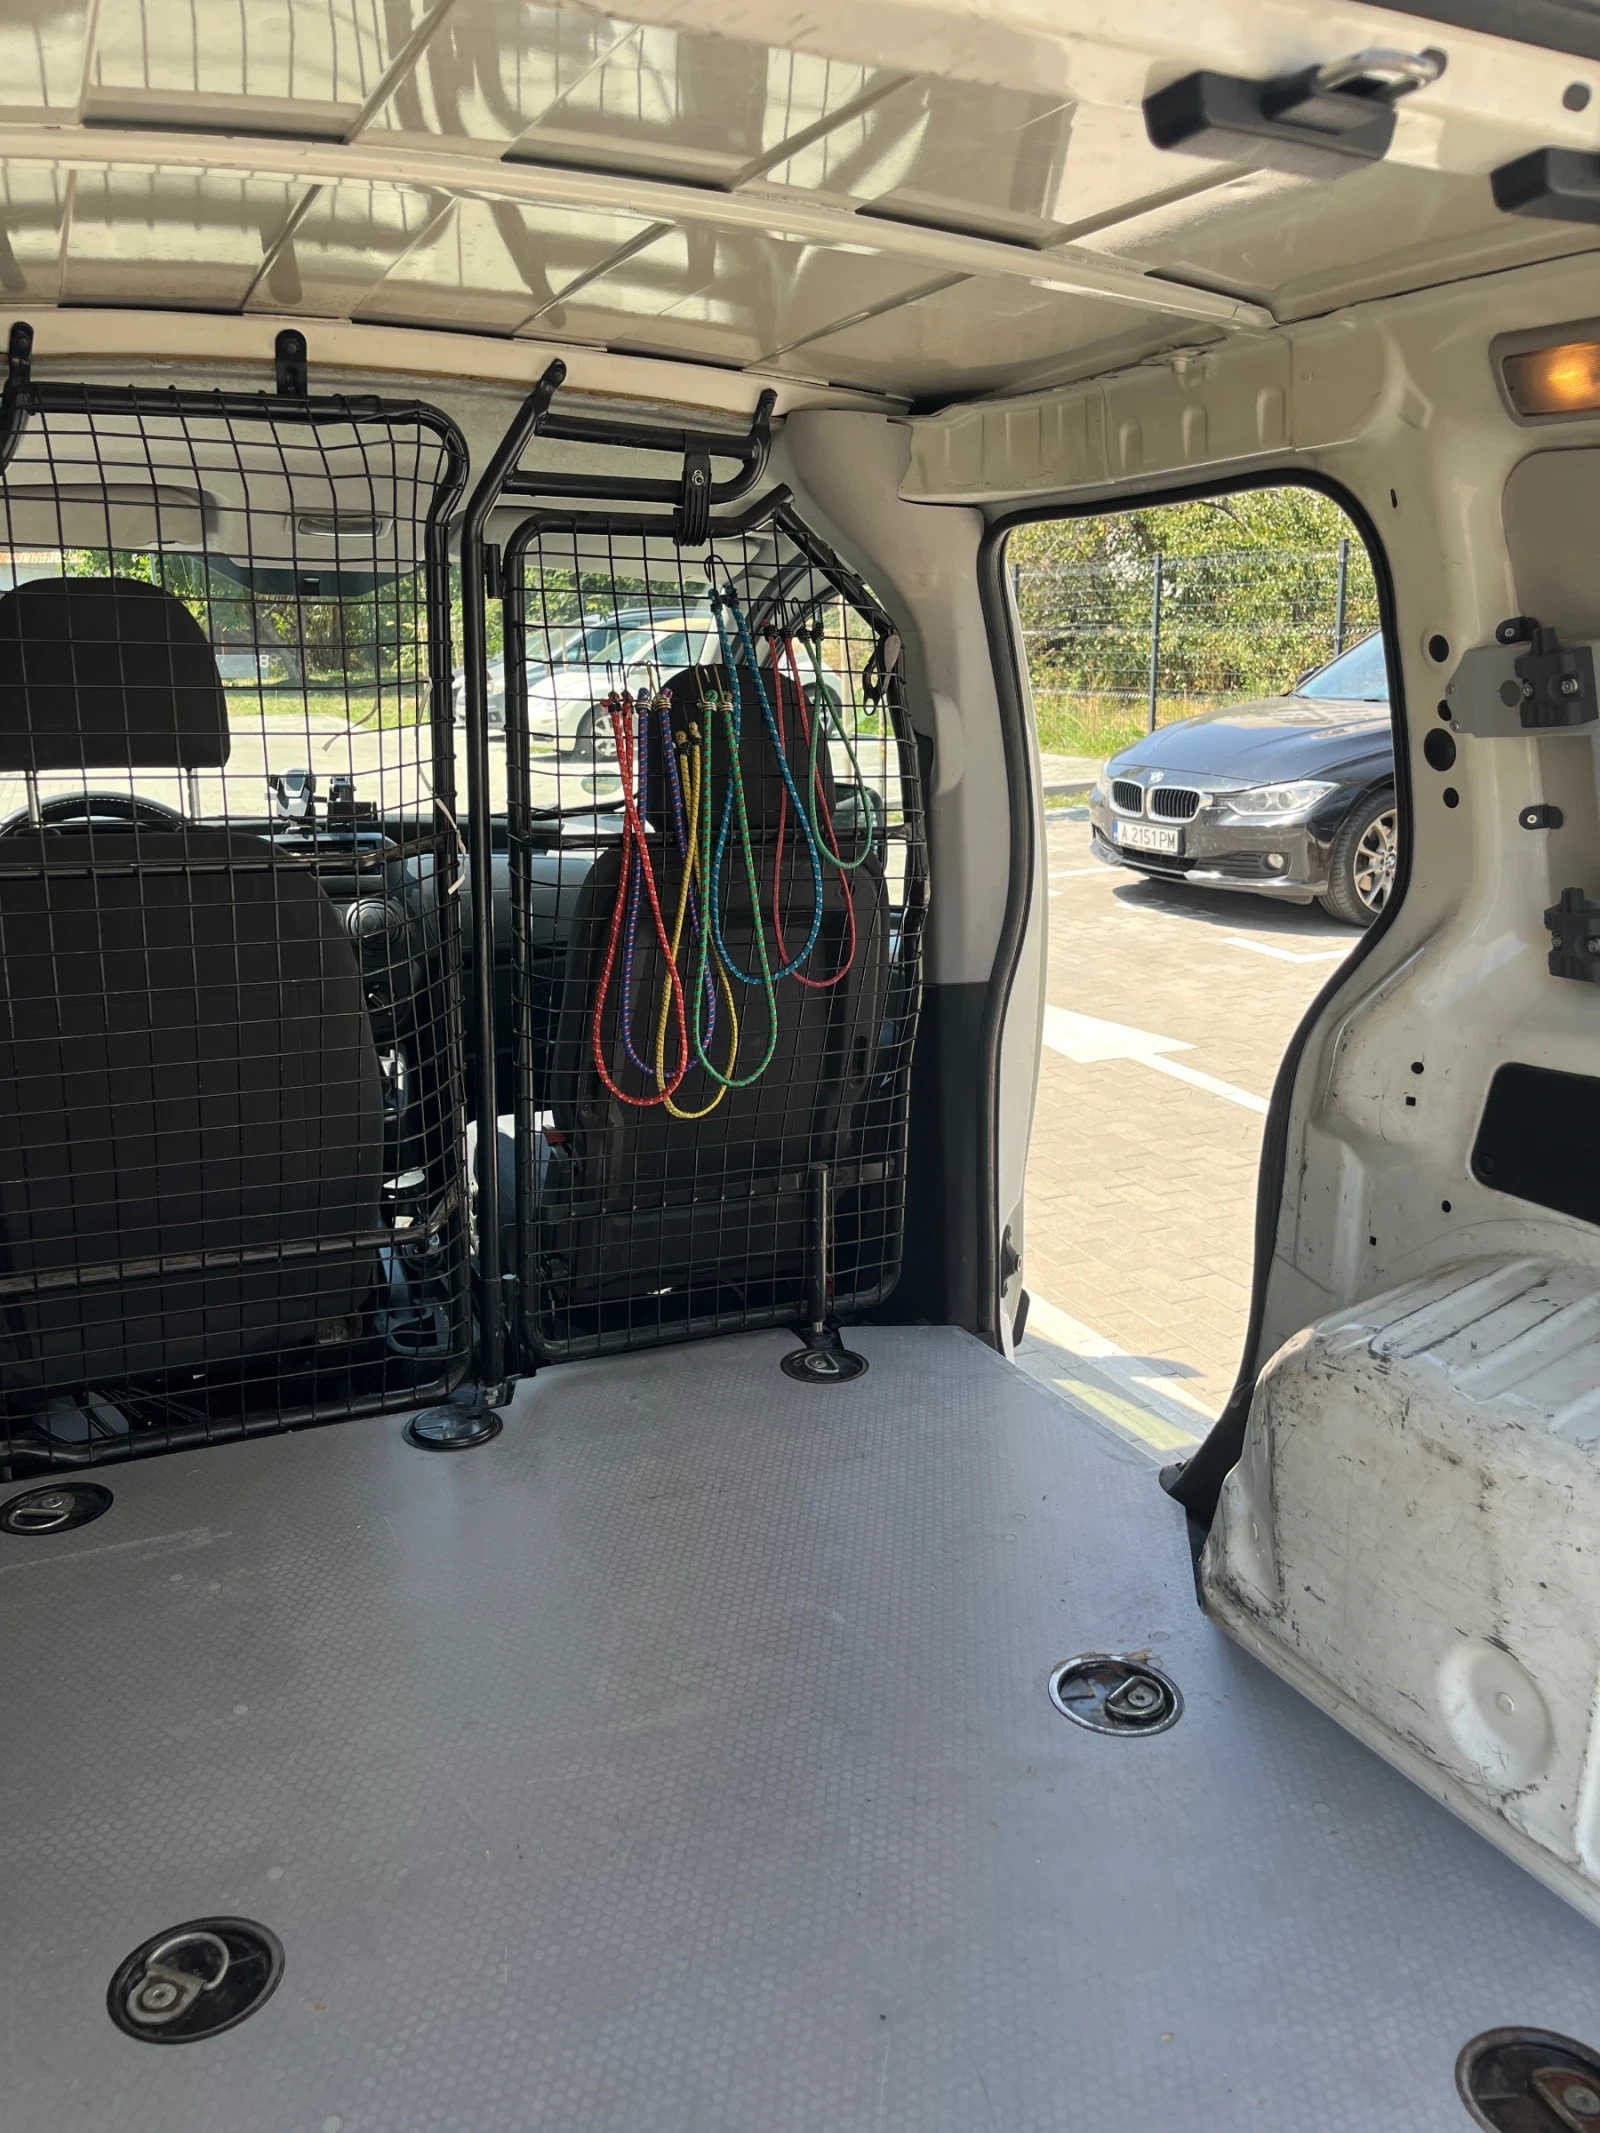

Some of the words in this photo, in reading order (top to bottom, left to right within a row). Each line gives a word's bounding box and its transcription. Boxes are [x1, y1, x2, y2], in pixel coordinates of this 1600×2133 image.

[1121, 824, 1127, 841] A
[1131, 826, 1156, 847] 2151
[1159, 831, 1176, 849] PM
